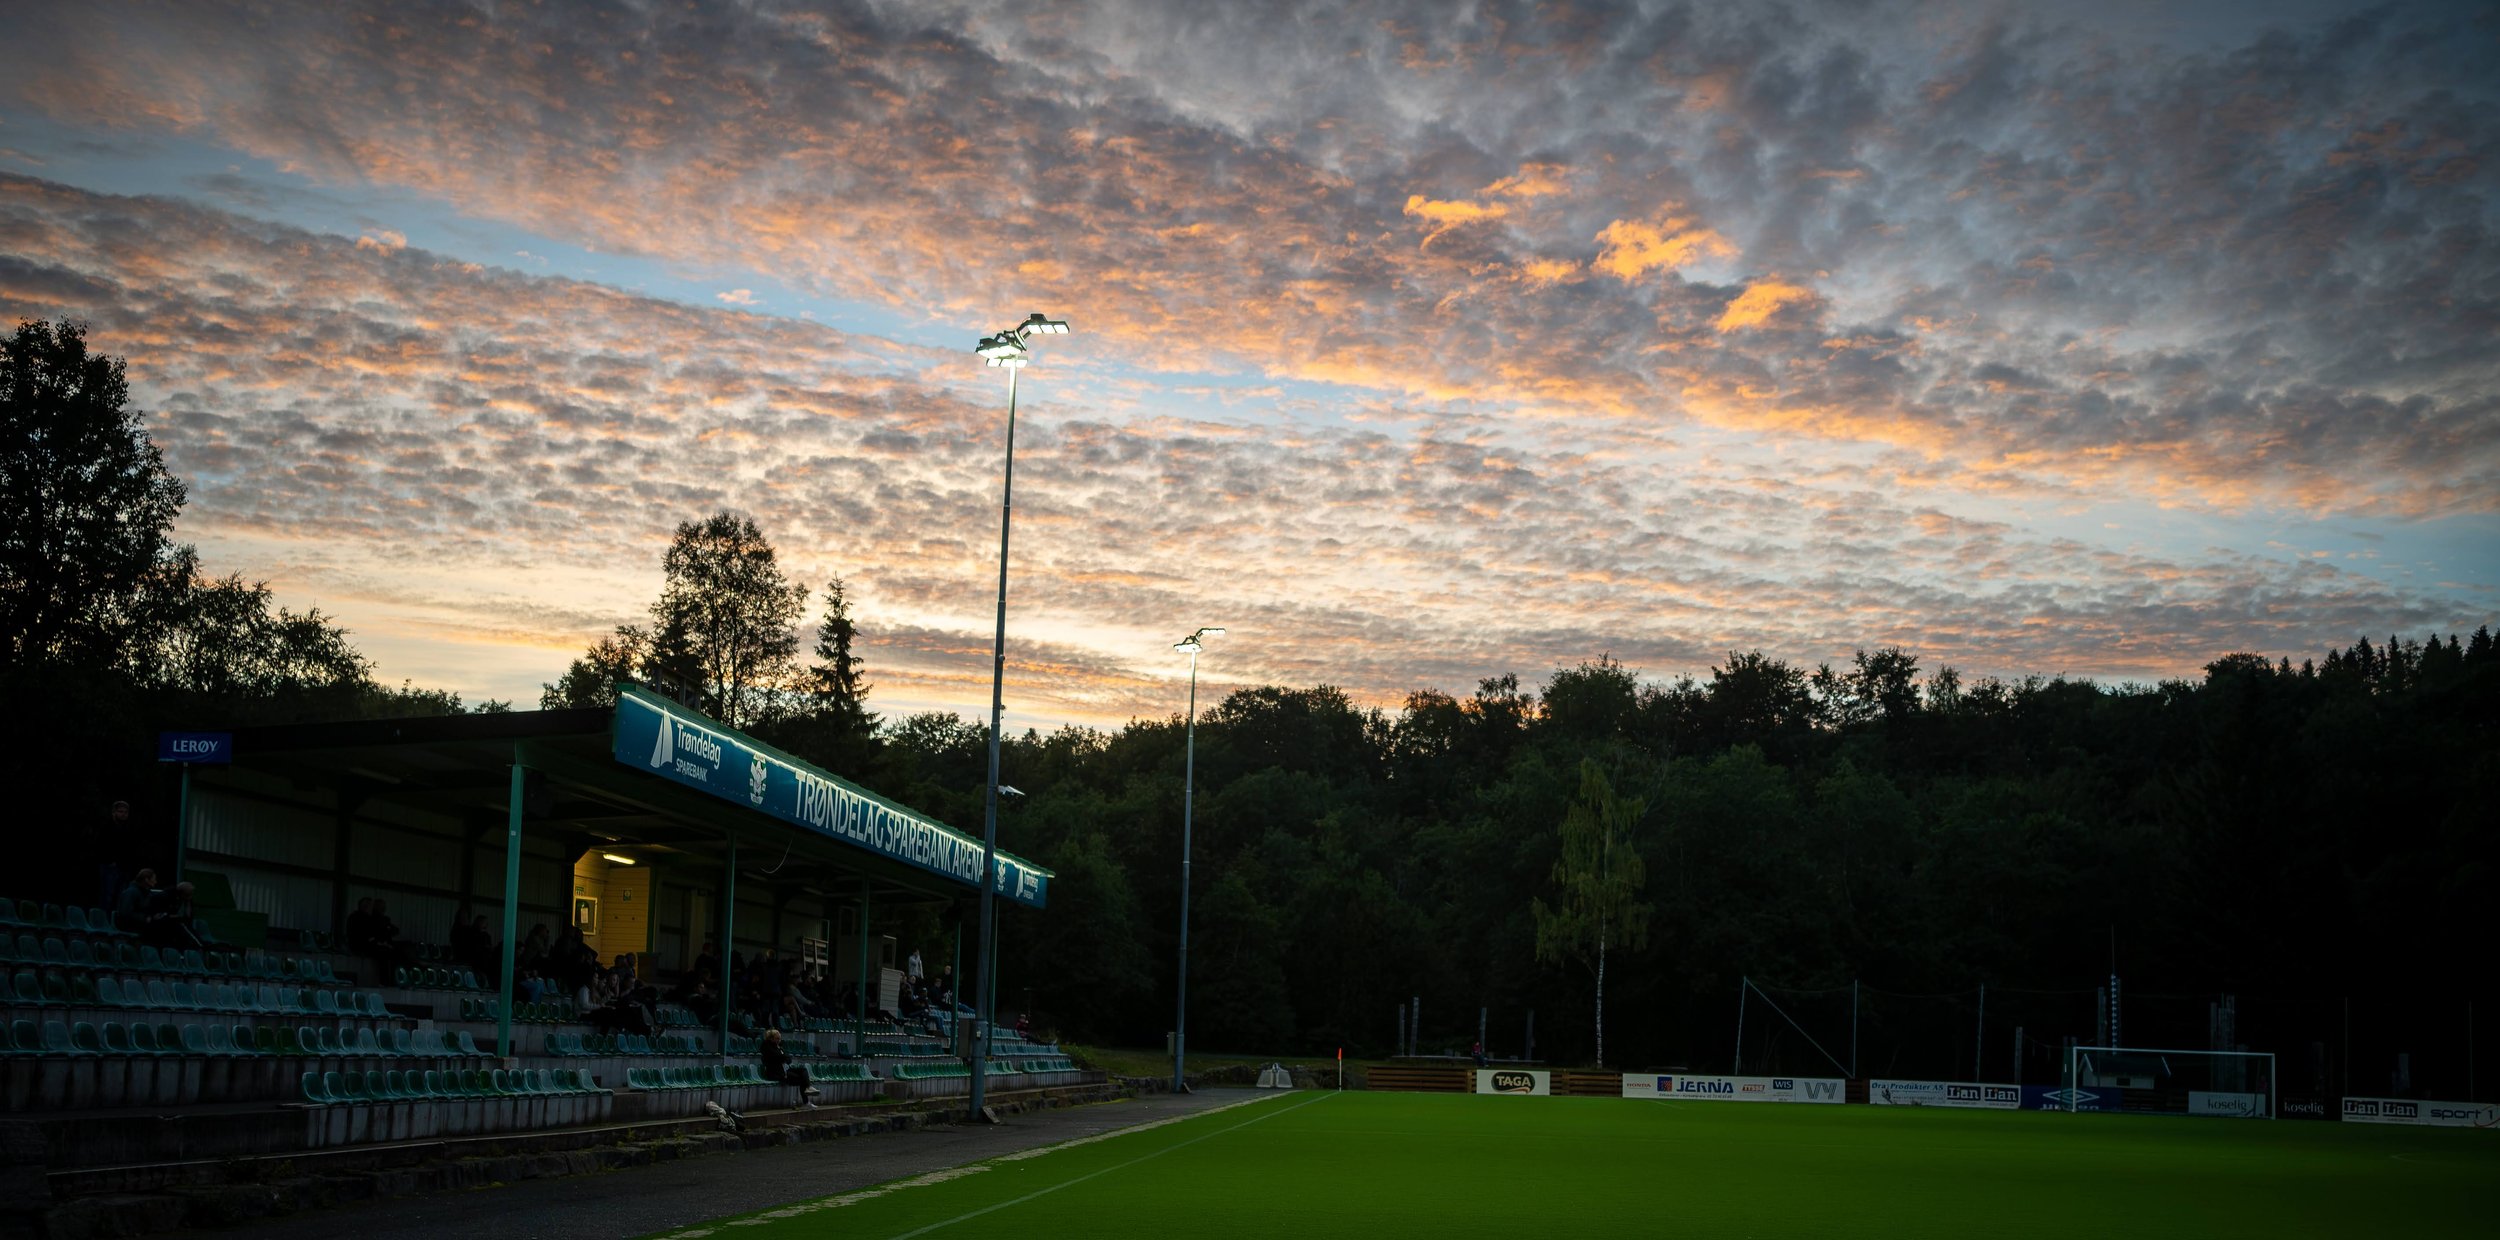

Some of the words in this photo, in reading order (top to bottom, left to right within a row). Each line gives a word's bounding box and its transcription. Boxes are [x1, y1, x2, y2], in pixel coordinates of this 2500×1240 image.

[173, 739, 218, 753] LERØY
[677, 723, 721, 770] Trøndelag
[675, 758, 708, 782] SPAREBANK
[795, 770, 885, 849] TRØNDELAG
[885, 811, 953, 873] SPAREBANK
[952, 837, 985, 883] ARENA
[1496, 1075, 1531, 1087] TAGA
[1774, 1081, 1792, 1089] WIS
[1890, 1083, 1930, 1091] Produkter
[1948, 1087, 1979, 1100] Lian
[1986, 1088, 2017, 1101] Lian
[2344, 1102, 2377, 1115] Lian
[2383, 1103, 2417, 1117] Lian
